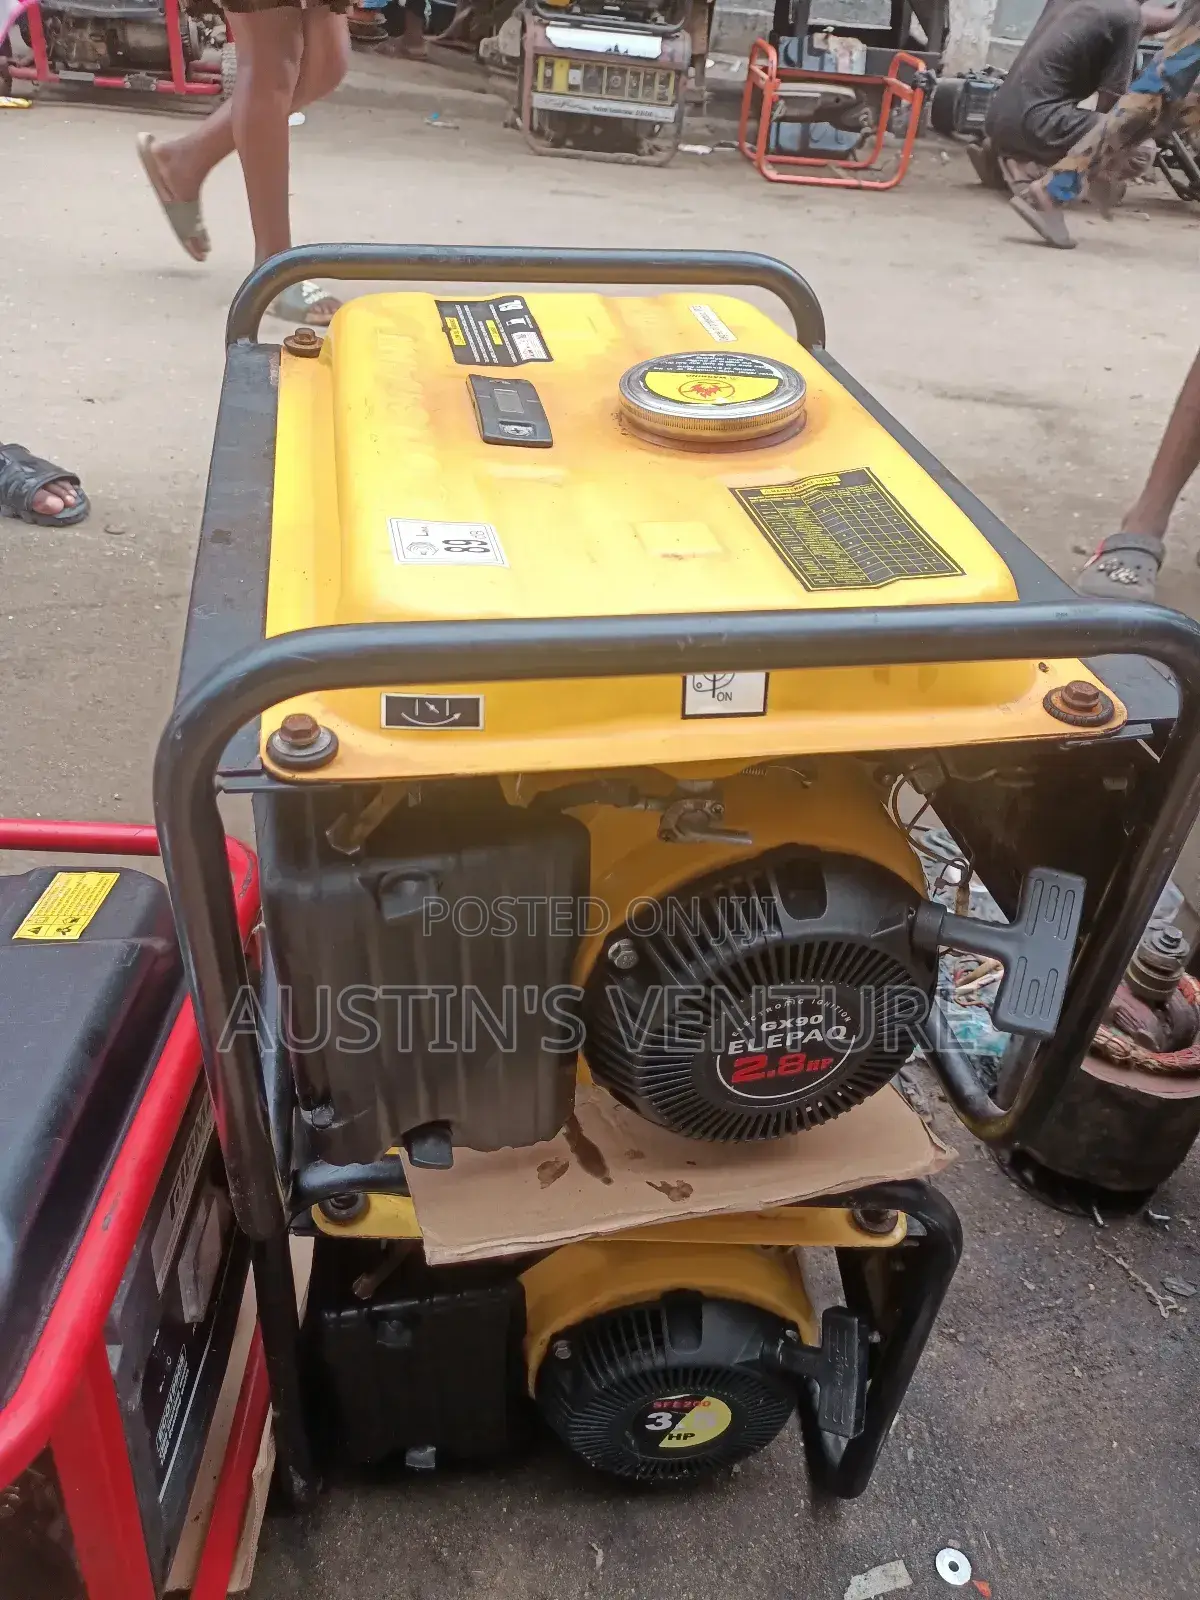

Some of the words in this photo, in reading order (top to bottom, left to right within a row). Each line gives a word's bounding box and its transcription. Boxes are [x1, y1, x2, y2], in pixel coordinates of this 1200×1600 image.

[441, 539, 490, 553] 89
[716, 691, 733, 702] ON
[760, 1014, 824, 1032] GX90
[728, 1025, 848, 1055] ELEPAQ
[667, 1432, 696, 1441] HP
